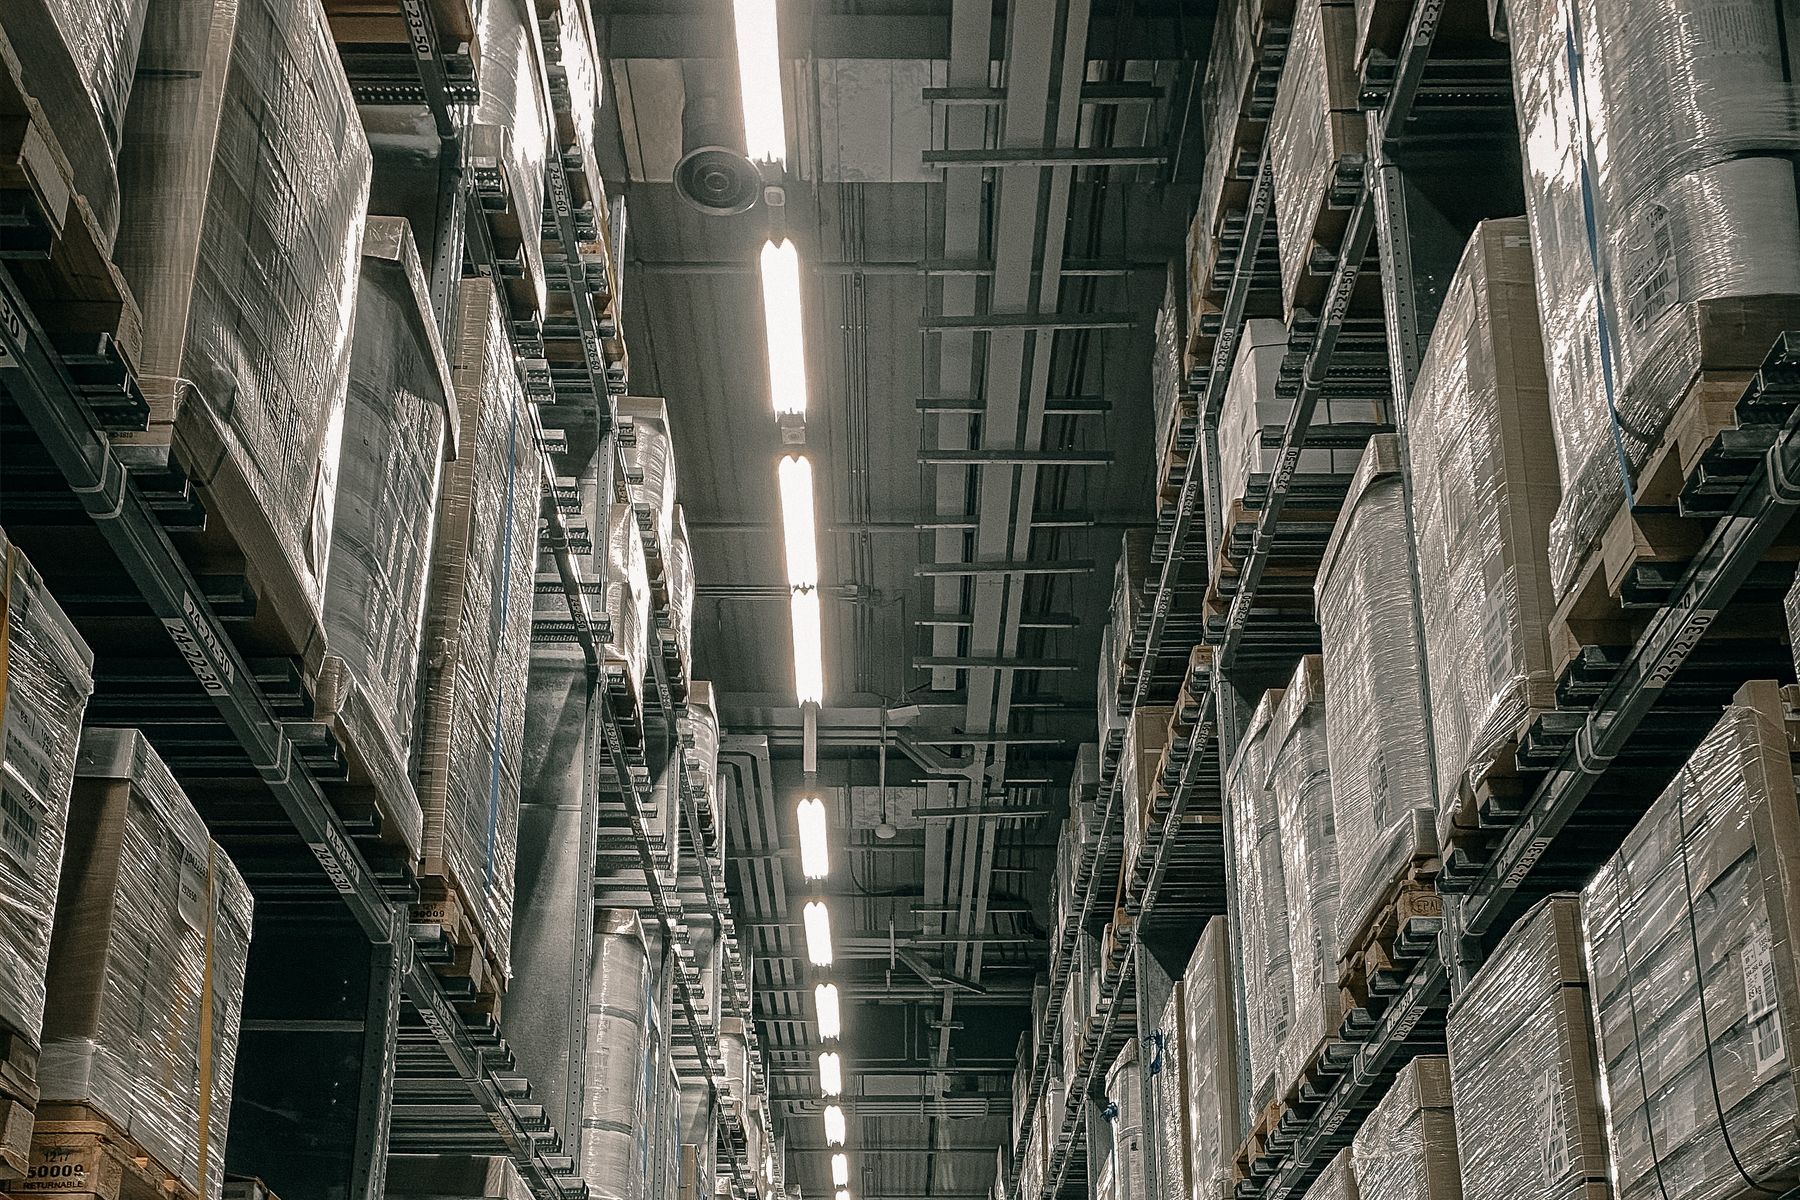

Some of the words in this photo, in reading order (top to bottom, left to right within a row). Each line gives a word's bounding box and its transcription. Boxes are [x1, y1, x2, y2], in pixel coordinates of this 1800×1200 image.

[551, 168, 568, 212] 24-25-60
[1256, 164, 1272, 209] 22-25-60
[1332, 270, 1356, 320] 22-24-50
[584, 334, 600, 370] 24-26-60
[1217, 331, 1232, 368] 22-26-60
[1276, 451, 1297, 489] 22-25-50
[1234, 595, 1250, 627] 22-26-50
[166, 626, 222, 690] 24-22-30
[188, 601, 230, 676] 24-22-30
[1650, 616, 1712, 682] 22-22-30
[312, 847, 352, 890] 24-23-30
[1505, 841, 1548, 884] 22-23-30
[1393, 1008, 1425, 1038] 22-24-30
[23, 1181, 84, 1190] RETURNABLE
